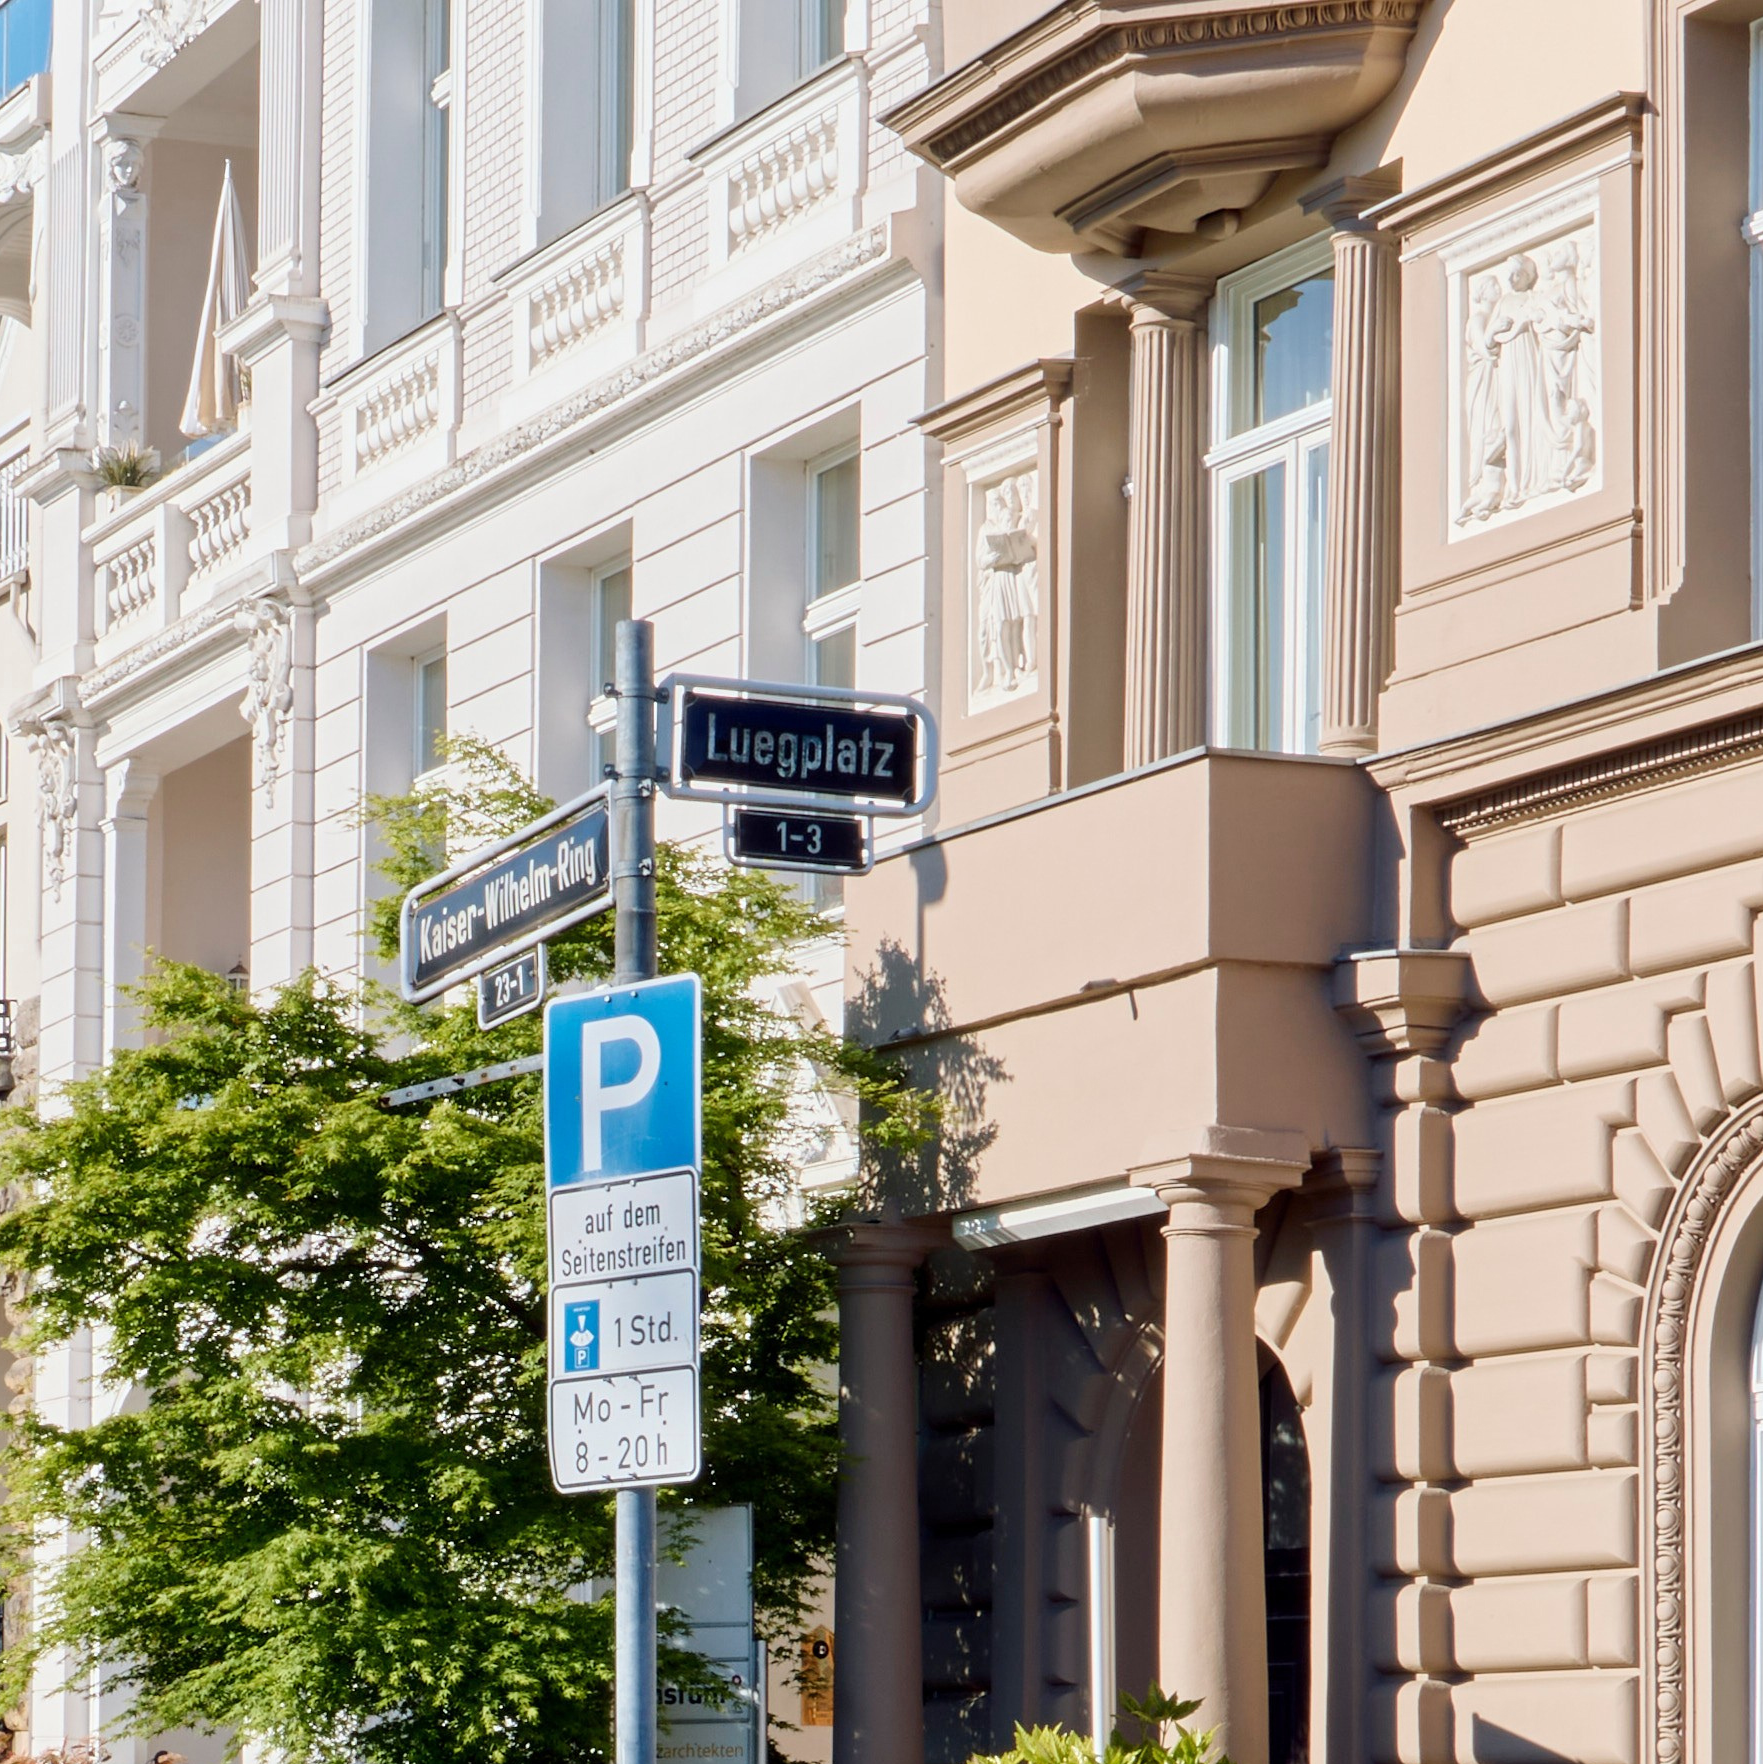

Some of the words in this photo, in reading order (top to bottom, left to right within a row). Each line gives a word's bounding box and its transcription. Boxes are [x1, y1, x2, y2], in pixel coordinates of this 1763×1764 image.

[708, 712, 896, 779] Luegplatz
[776, 820, 823, 855] 1-3
[419, 835, 598, 965] Kaiser-Wilhelm-Ring
[494, 965, 524, 1008] 23-1
[581, 1014, 662, 1173] P
[584, 1204, 614, 1235] auf
[623, 1199, 661, 1229] dem
[561, 1236, 687, 1278] Seitenstreifen
[614, 1317, 622, 1348] 1
[630, 1311, 679, 1346] Std.
[577, 1349, 587, 1366] P
[573, 1391, 612, 1427] Mo
[639, 1384, 669, 1419] Fr
[576, 1441, 589, 1474] 8
[618, 1436, 649, 1469] 20
[656, 1433, 669, 1466] h
